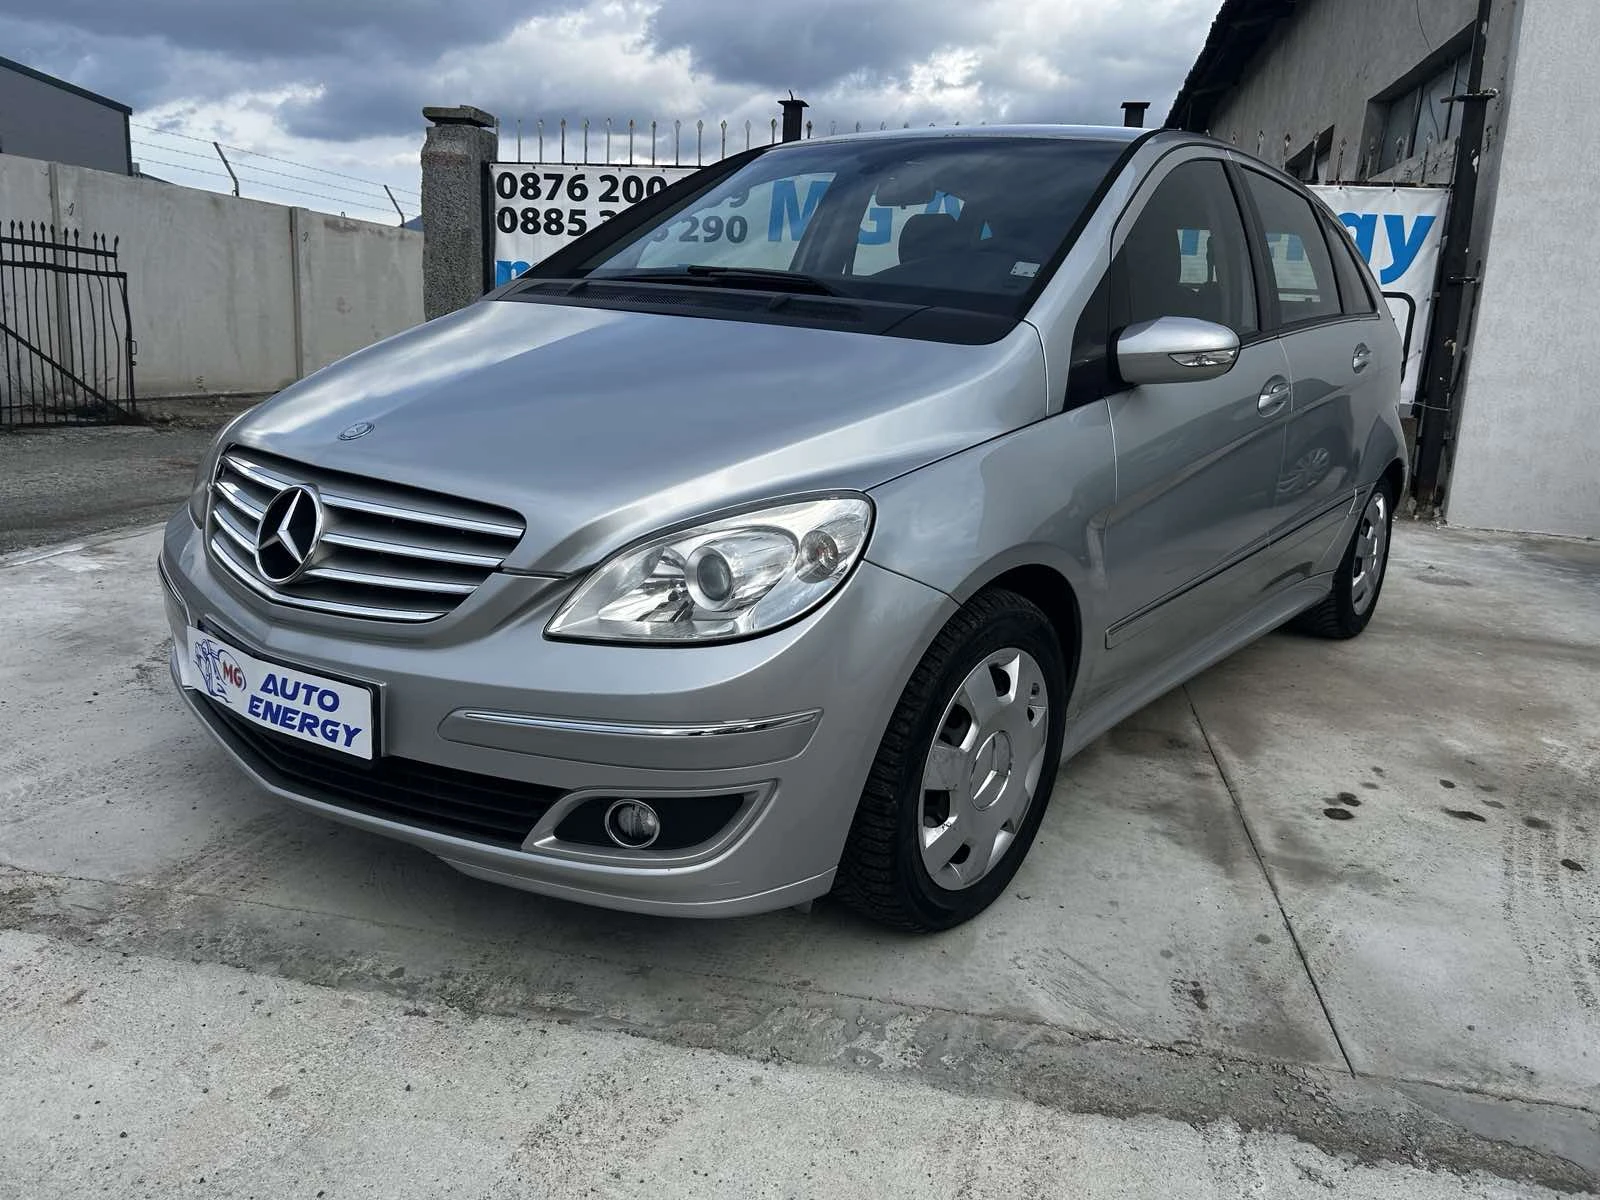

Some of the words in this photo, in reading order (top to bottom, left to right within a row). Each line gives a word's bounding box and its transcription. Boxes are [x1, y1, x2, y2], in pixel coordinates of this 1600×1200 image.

[496, 172, 589, 202] 0876
[496, 206, 588, 237] 0885
[678, 215, 748, 244] 290
[222, 660, 243, 689] MG
[260, 673, 340, 713] AUTO
[247, 694, 363, 748] ENERGY
